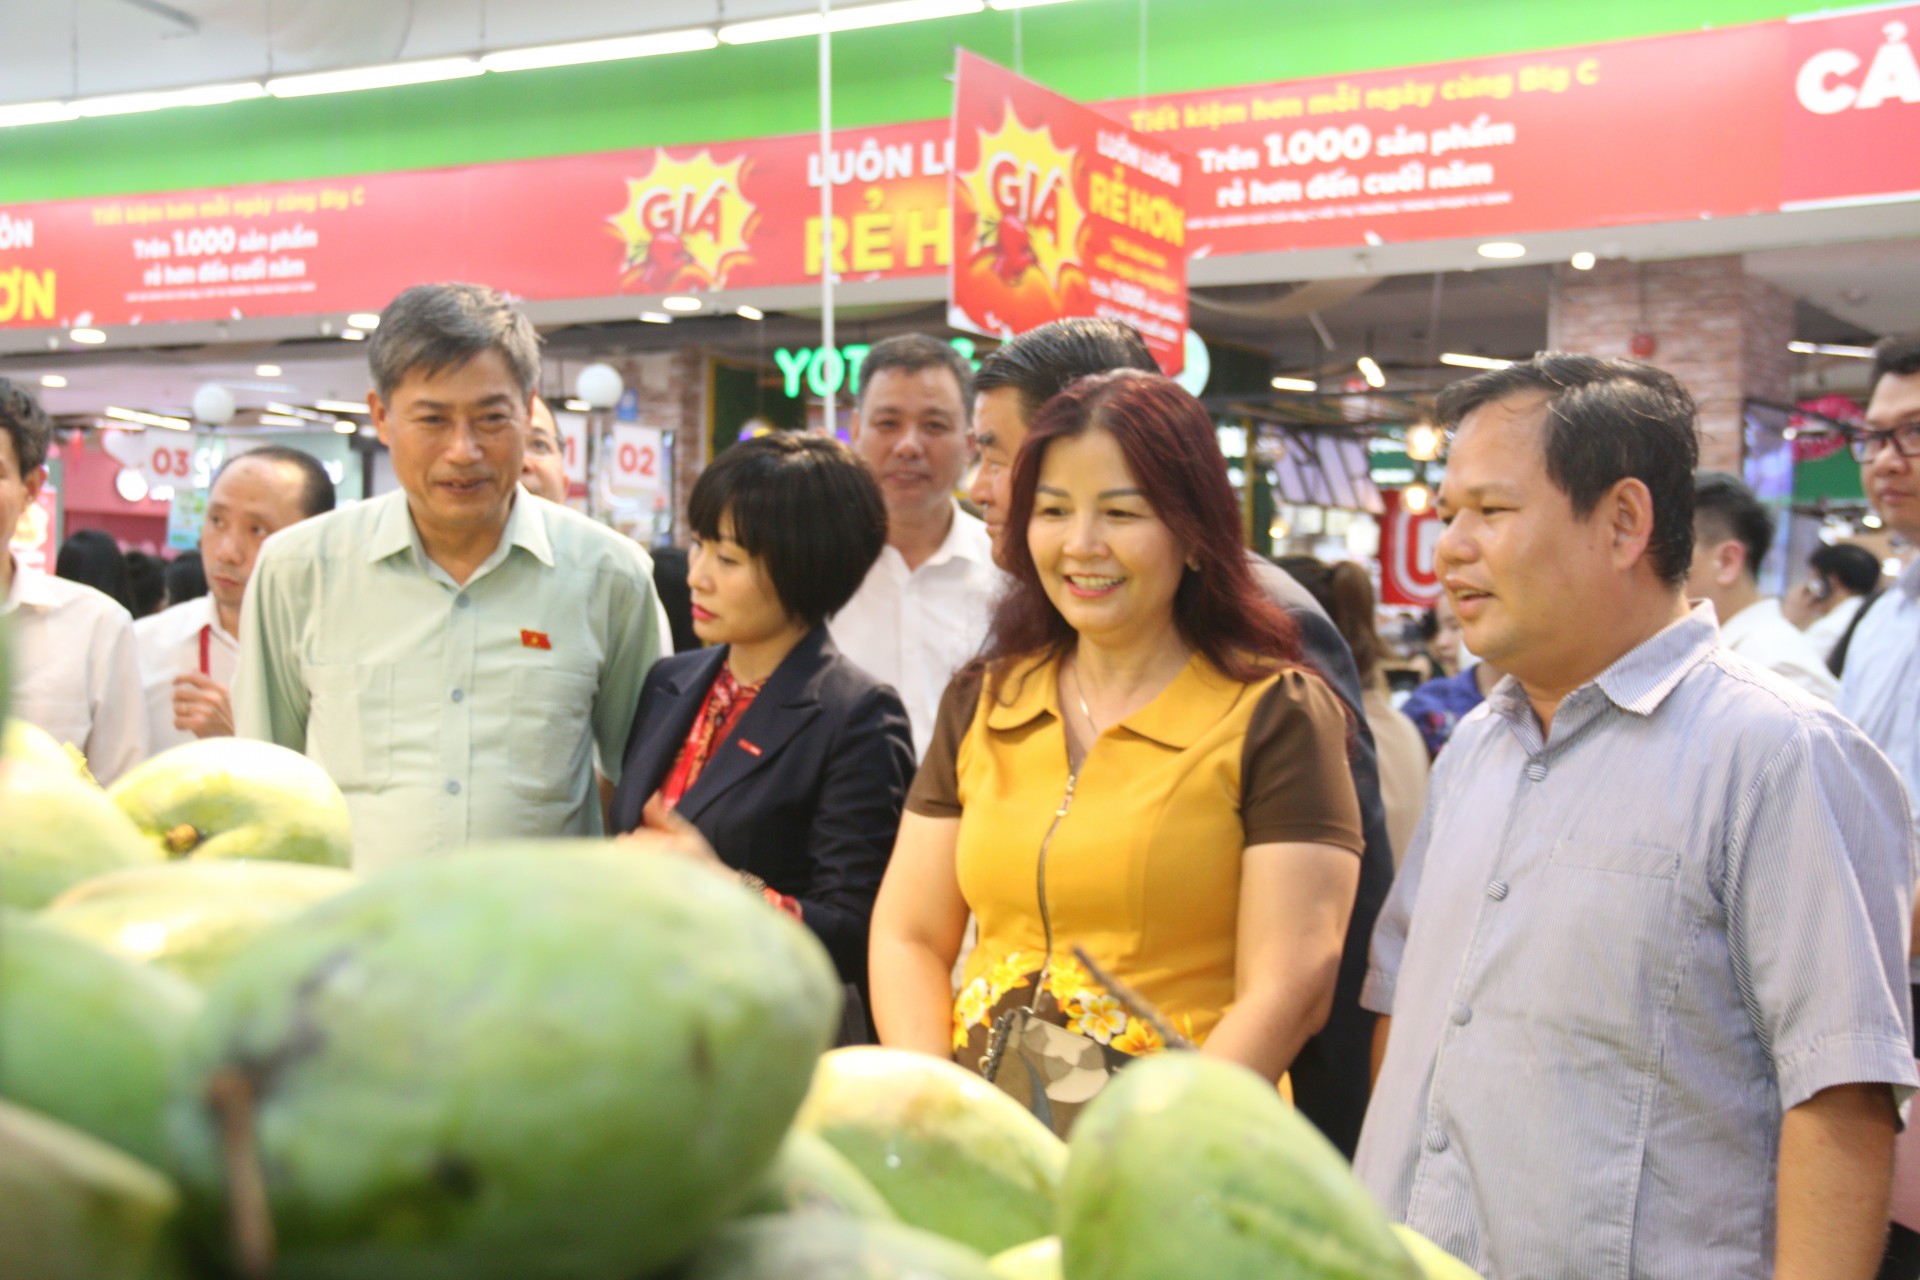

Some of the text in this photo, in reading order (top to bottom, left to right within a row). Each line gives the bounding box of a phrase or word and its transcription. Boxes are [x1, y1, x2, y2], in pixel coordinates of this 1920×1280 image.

[808, 139, 912, 187] LUÔN
[1197, 145, 1259, 174] Trên
[1263, 124, 1371, 167] 1.000
[152, 447, 190, 478] 03
[618, 443, 655, 477] 02
